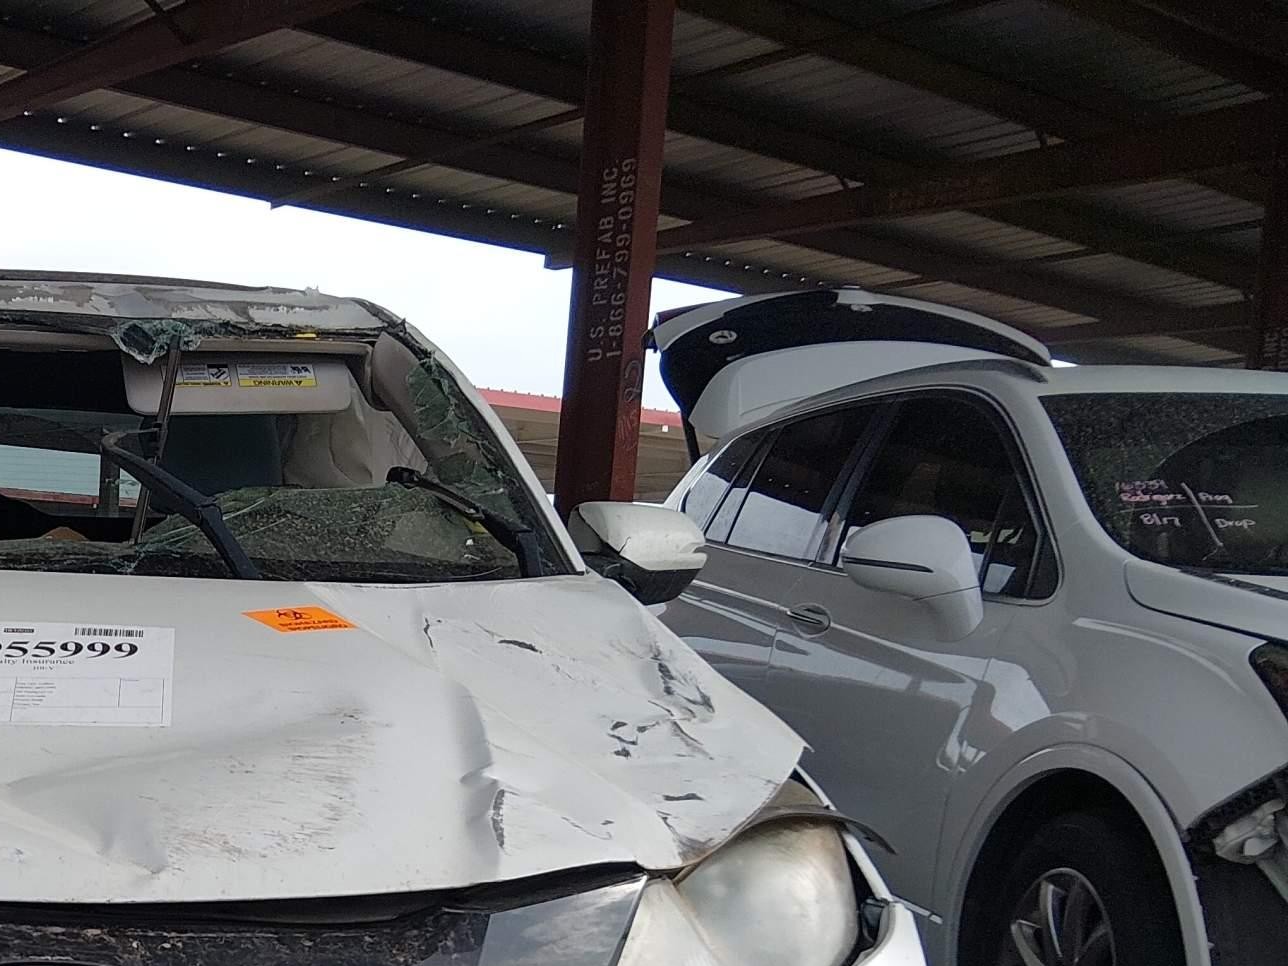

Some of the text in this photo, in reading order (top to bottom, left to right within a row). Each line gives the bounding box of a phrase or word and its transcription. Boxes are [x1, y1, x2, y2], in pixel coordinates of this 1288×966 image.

[588, 159, 619, 362] U.S. PREFAB INC.
[606, 157, 637, 359] 1-866-799-0969
[1214, 518, 1256, 529] Drop
